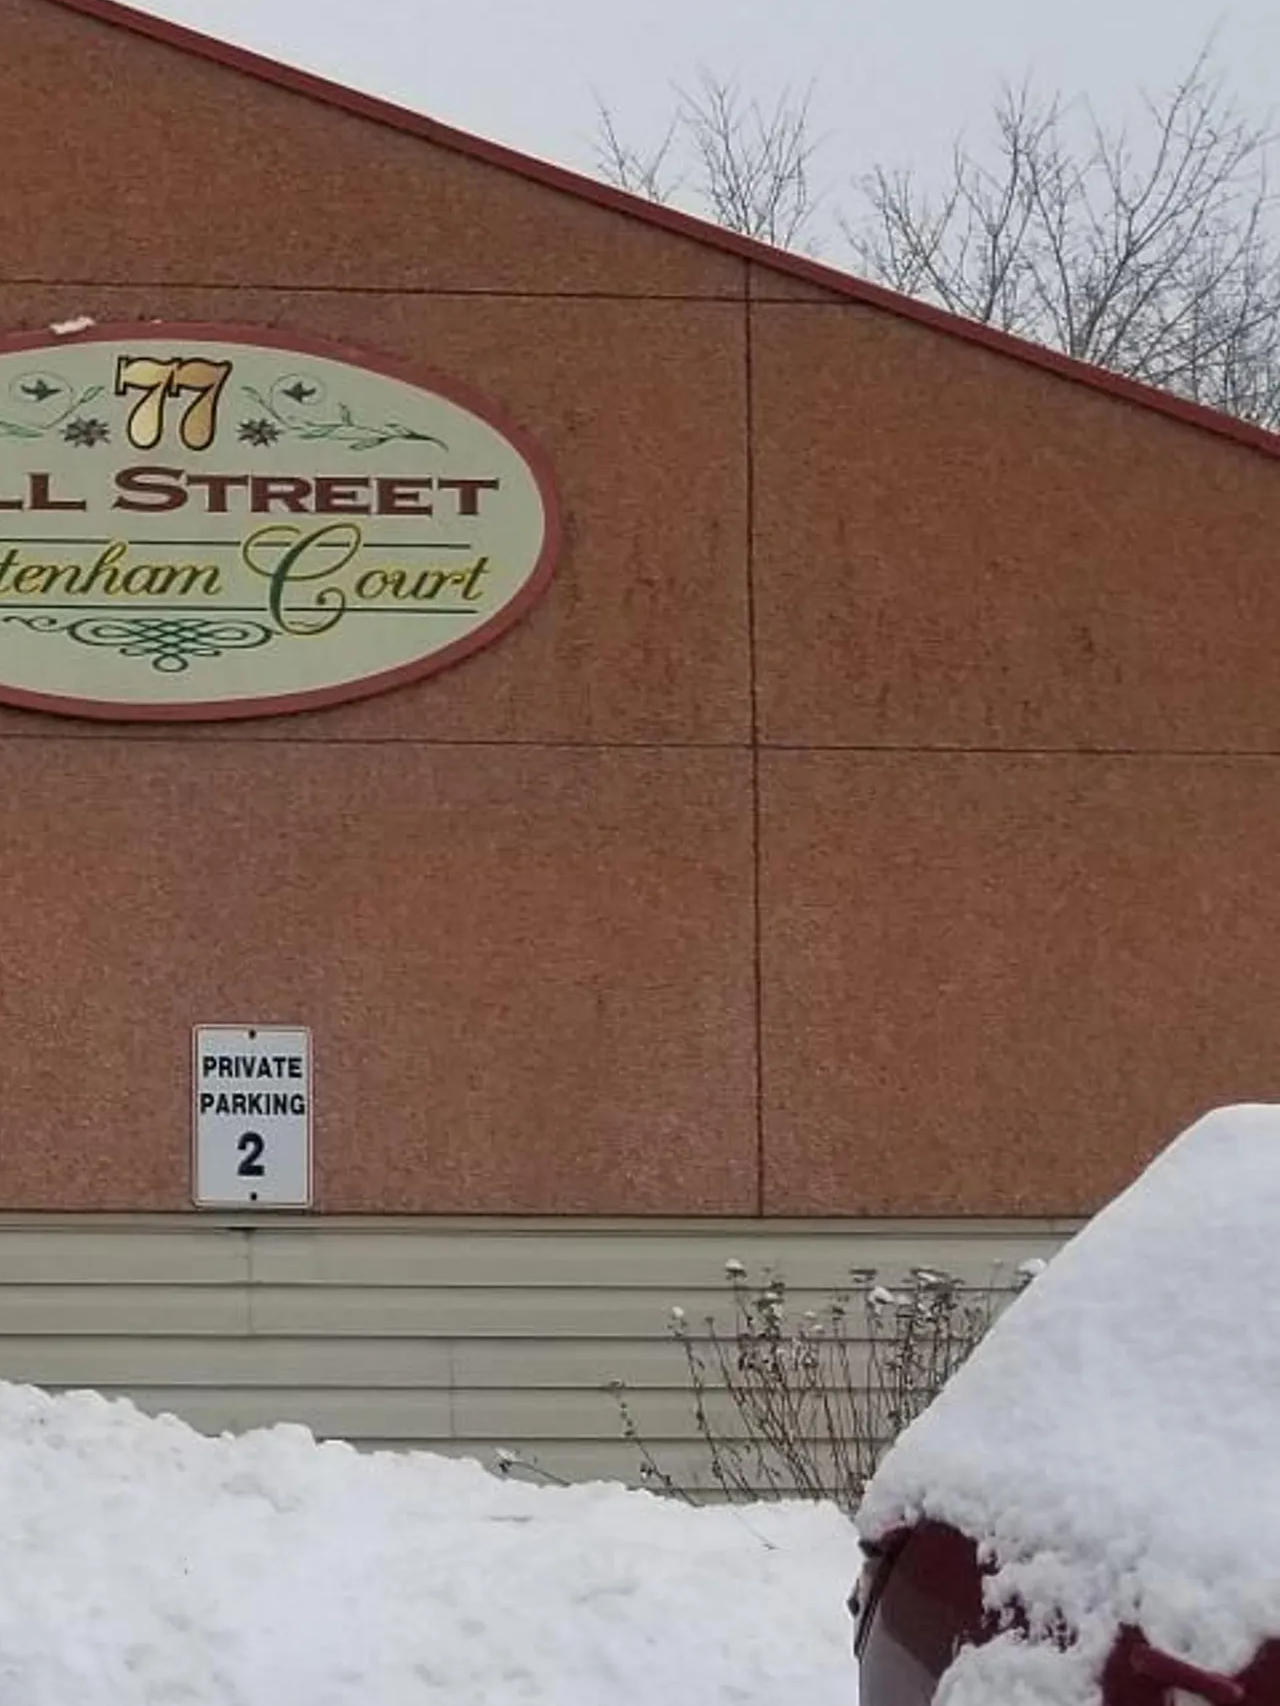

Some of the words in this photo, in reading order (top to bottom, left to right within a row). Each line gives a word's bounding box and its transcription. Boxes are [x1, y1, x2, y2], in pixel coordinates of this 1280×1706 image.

[115, 355, 233, 452] 77
[112, 465, 500, 516] STREET
[242, 522, 491, 635] Court
[202, 1056, 303, 1078] PRIVATE
[200, 1093, 305, 1115] PARKING
[237, 1132, 265, 1176] 2
